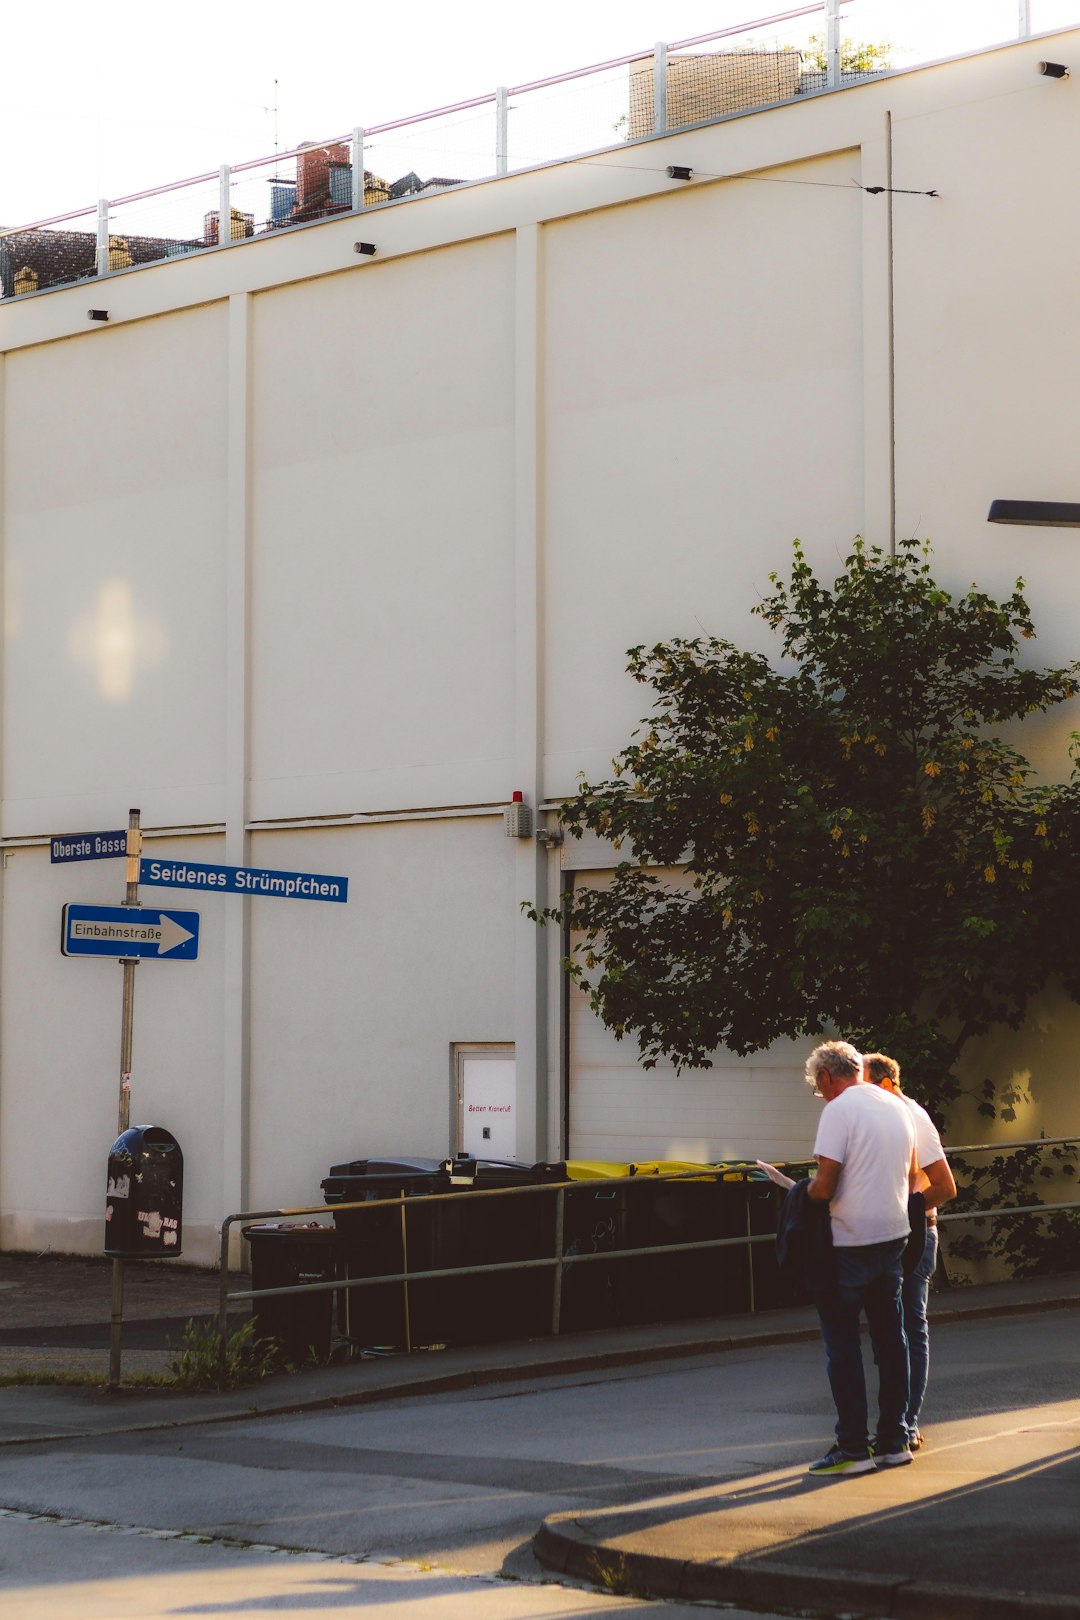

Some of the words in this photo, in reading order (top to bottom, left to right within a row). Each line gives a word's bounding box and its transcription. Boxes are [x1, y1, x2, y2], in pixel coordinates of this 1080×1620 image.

[53, 839, 91, 858] Oberste
[95, 836, 126, 853] Gasse
[149, 863, 227, 886] Seidenes
[234, 871, 340, 897] Strümpfchen
[75, 923, 162, 940] Einbahnstraße
[468, 1104, 486, 1112] Betten
